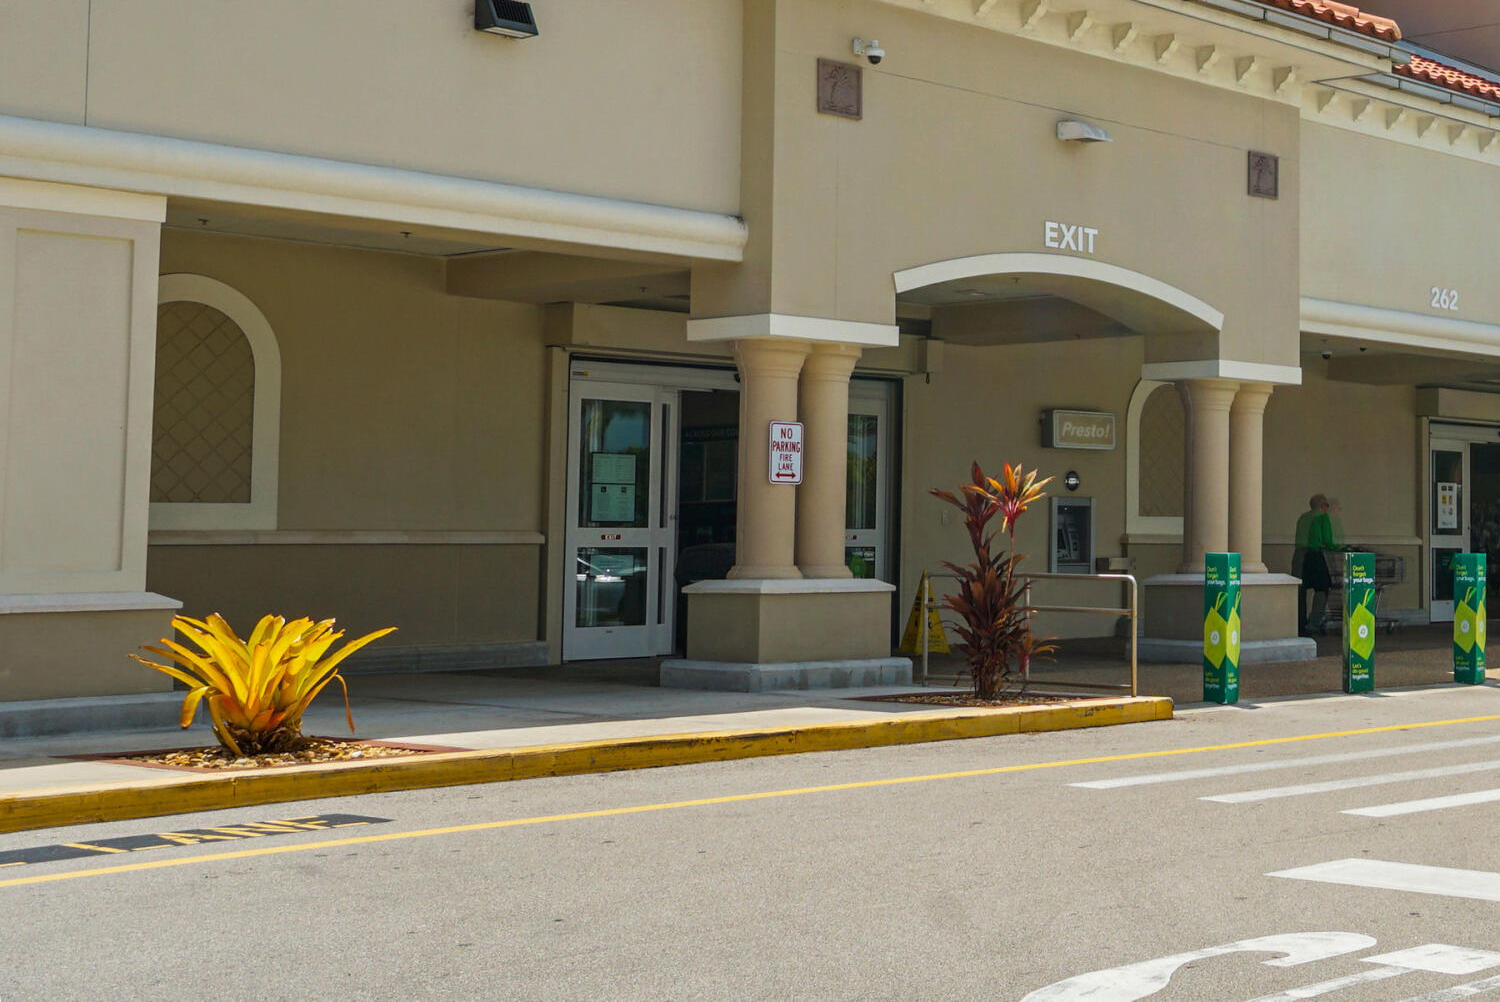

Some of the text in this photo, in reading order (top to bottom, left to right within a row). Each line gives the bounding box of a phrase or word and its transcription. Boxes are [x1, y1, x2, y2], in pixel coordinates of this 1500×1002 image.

[1045, 221, 1099, 254] EXIT
[1431, 286, 1459, 311] 262
[780, 428, 793, 439] NO
[1061, 421, 1111, 438] Presto!
[772, 440, 801, 453] PARKING
[778, 462, 794, 471] LANE
[60, 815, 372, 854] LANE
